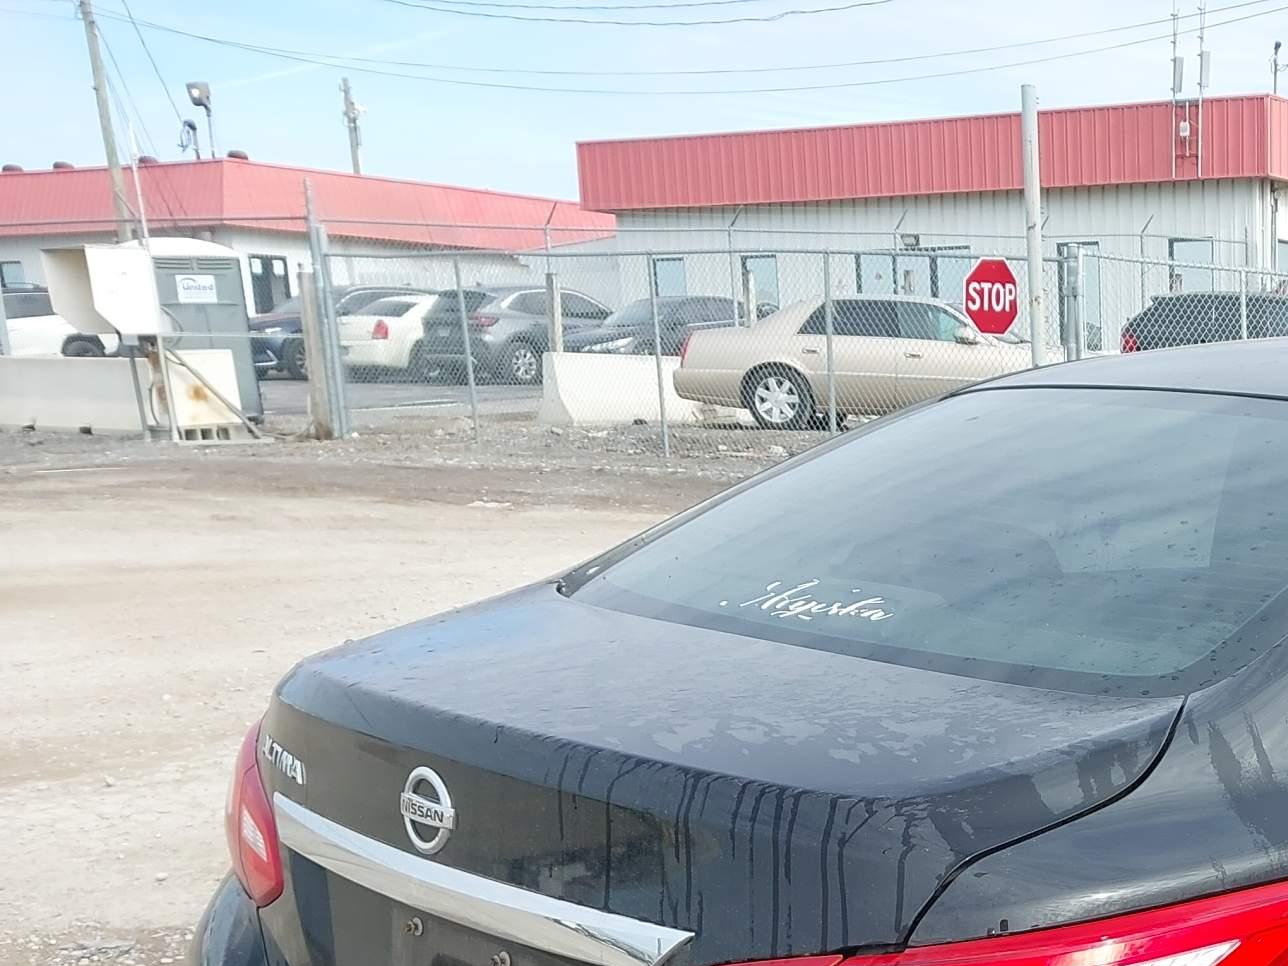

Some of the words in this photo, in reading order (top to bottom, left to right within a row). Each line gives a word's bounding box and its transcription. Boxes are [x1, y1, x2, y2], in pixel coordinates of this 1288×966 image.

[967, 281, 1016, 313] STOP
[262, 735, 307, 785] ALTIMA
[402, 798, 445, 823] NISSAN
